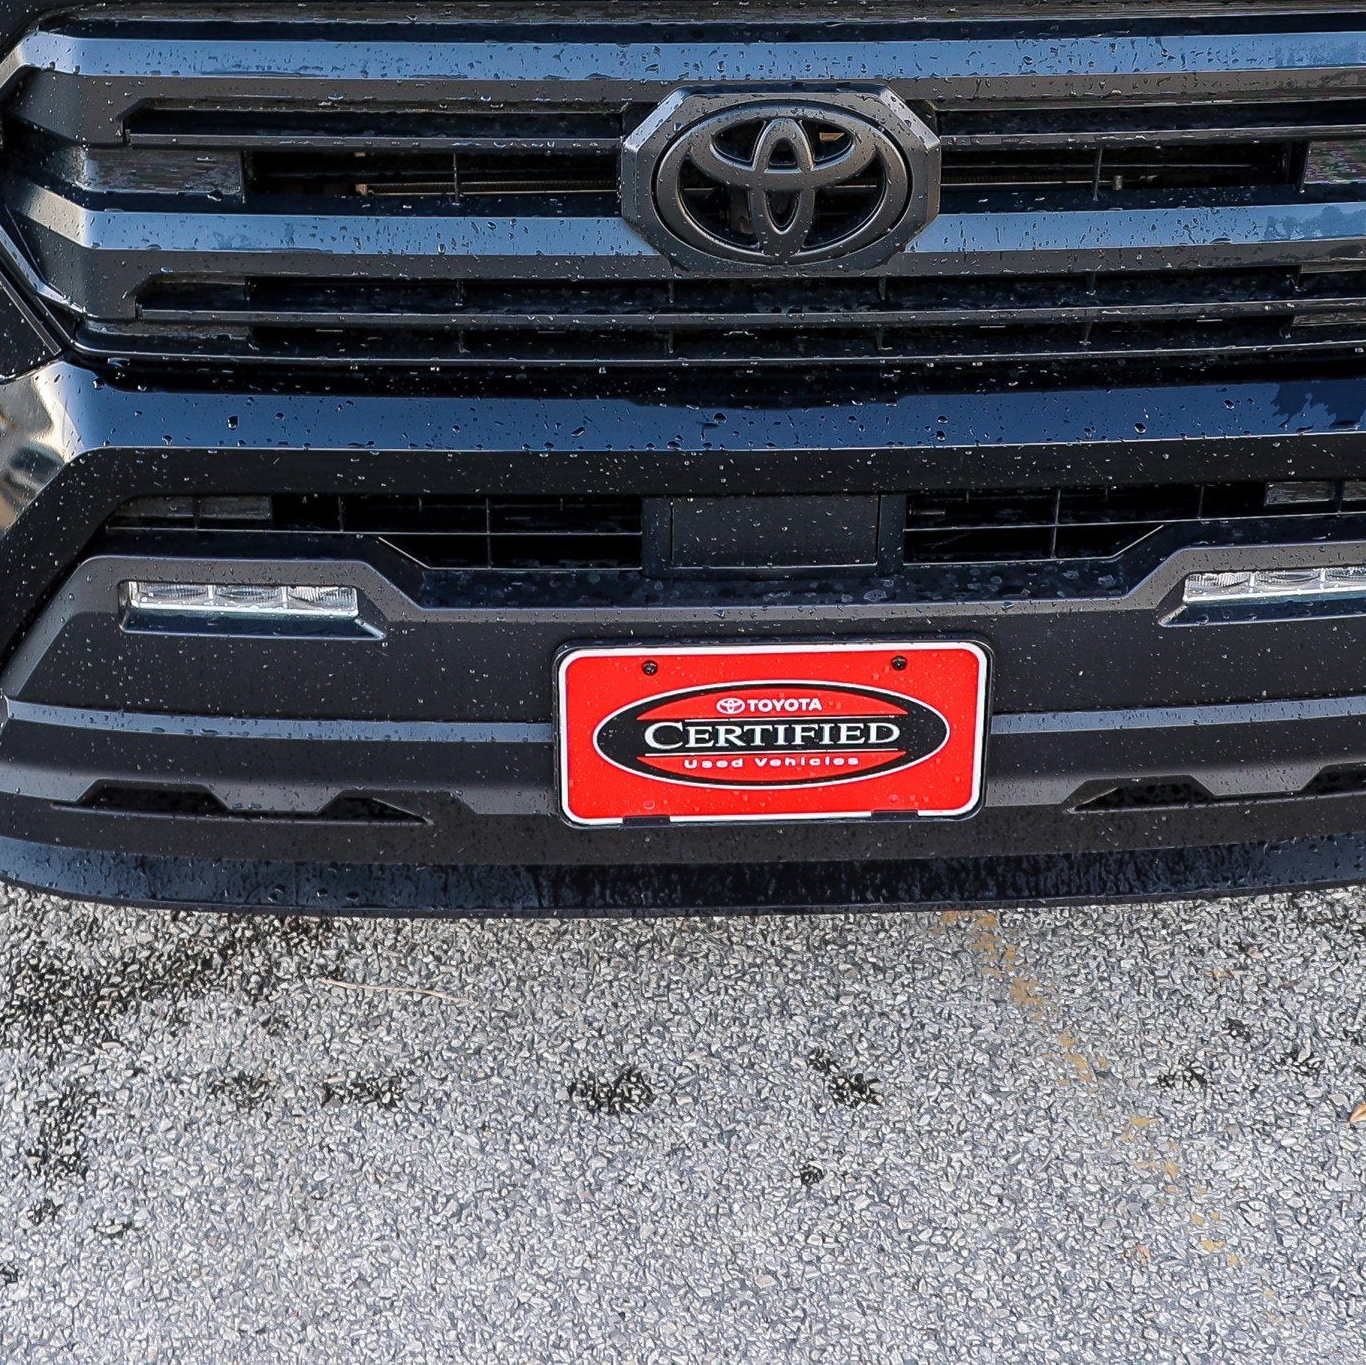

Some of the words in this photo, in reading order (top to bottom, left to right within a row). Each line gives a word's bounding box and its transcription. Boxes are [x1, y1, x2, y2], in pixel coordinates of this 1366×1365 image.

[746, 697, 823, 713] TOYOTA
[644, 720, 901, 751] CERTIFIED
[683, 757, 744, 769] Used
[754, 755, 859, 768] Vehicles
